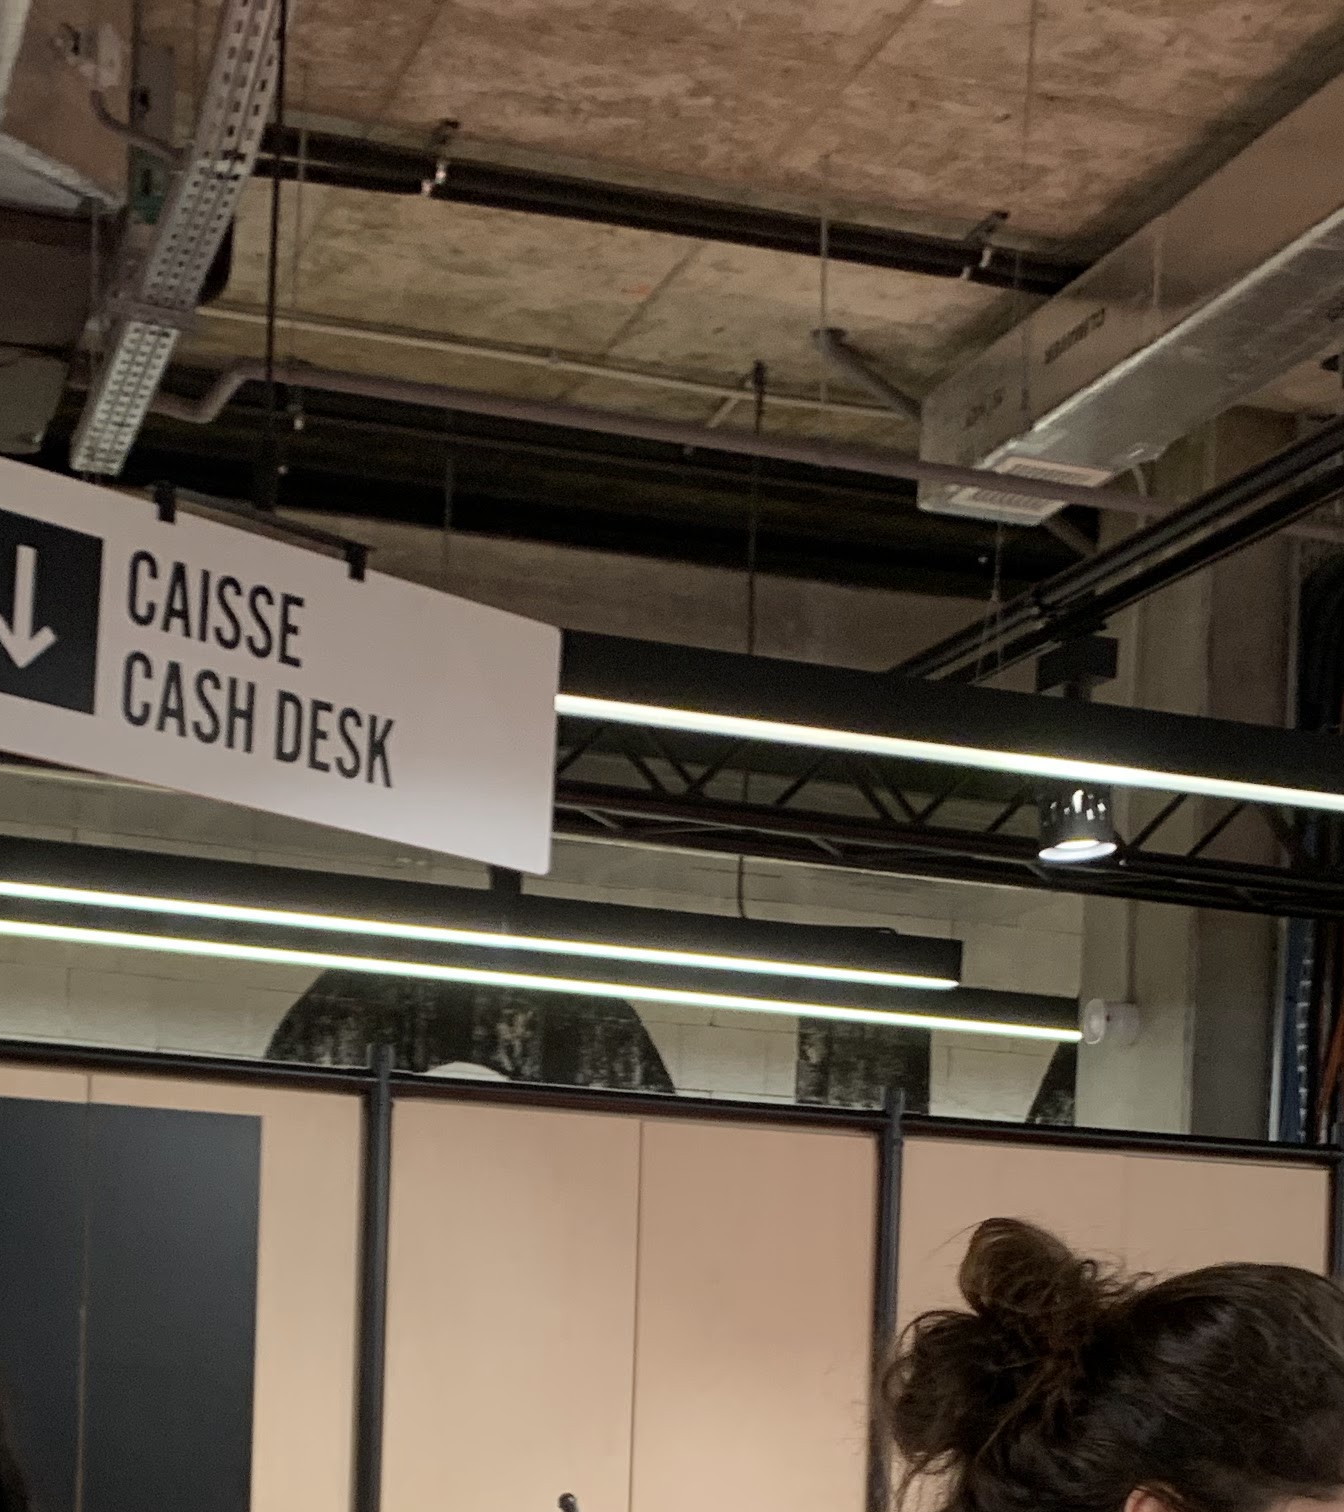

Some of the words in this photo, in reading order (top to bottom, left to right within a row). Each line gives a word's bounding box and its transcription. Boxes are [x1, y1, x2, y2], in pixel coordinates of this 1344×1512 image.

[127, 549, 306, 668] CAISSE
[122, 651, 256, 753] CASH
[275, 691, 396, 789] DESK
